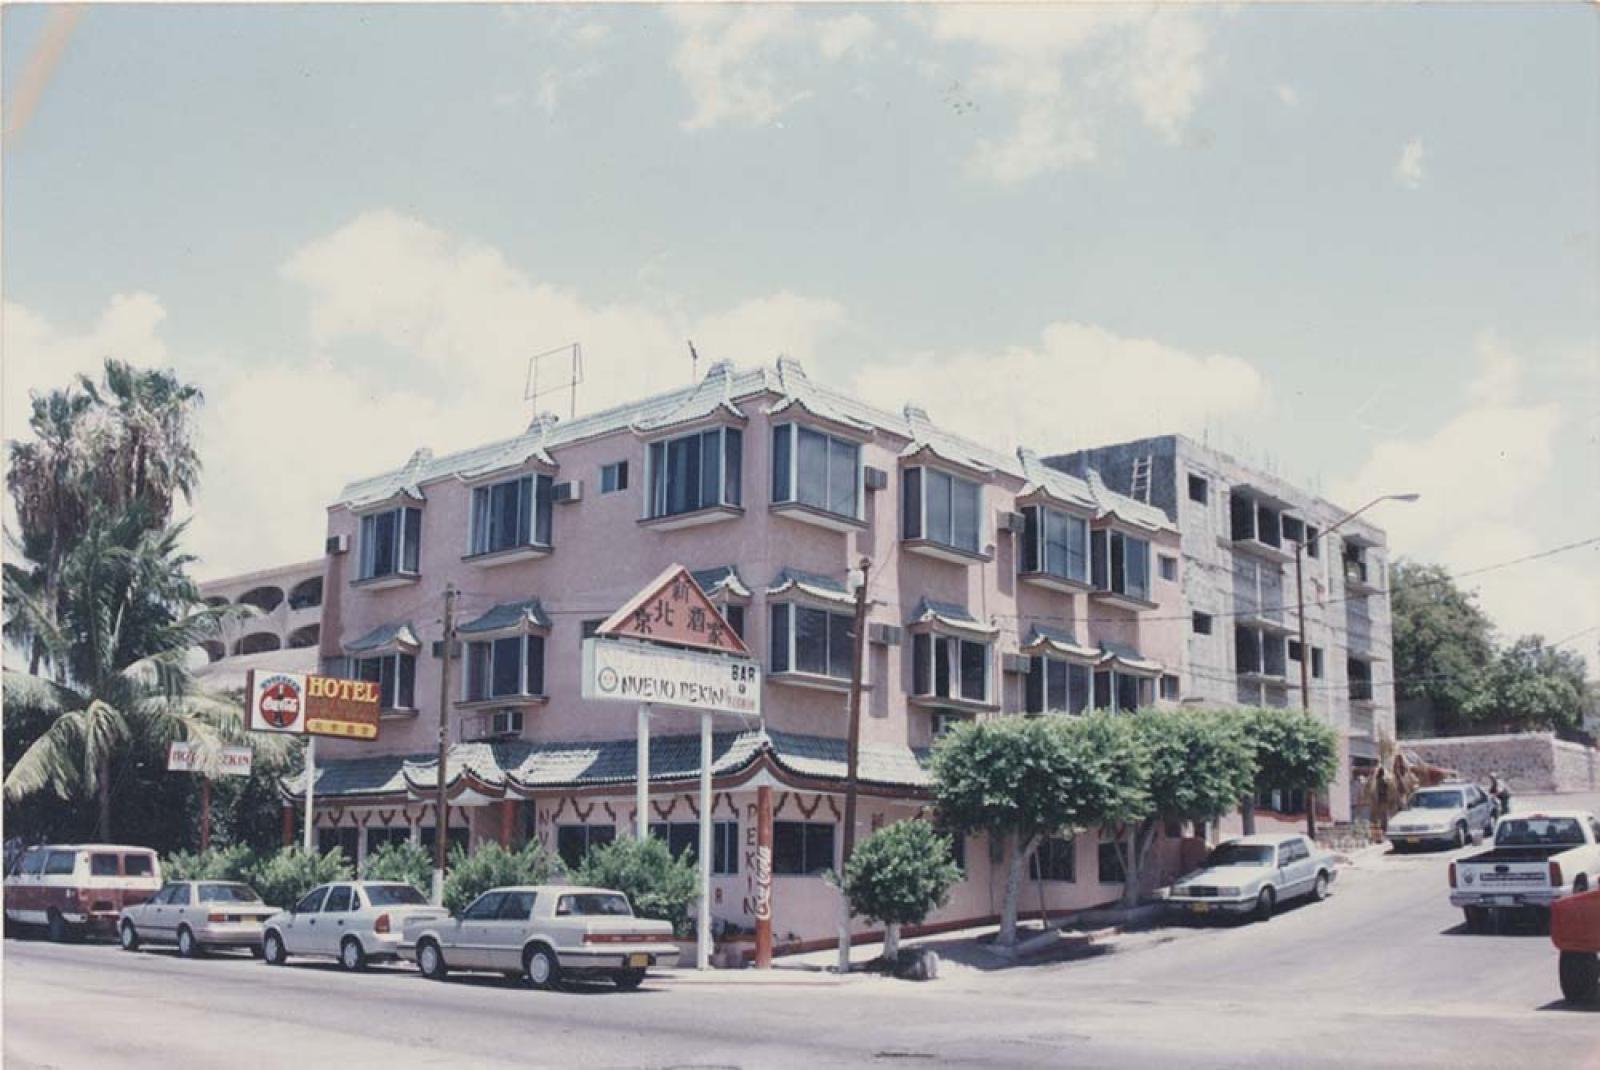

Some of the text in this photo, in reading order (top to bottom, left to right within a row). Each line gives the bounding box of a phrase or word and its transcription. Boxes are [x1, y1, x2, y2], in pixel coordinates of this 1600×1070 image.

[732, 664, 756, 683] BAR
[308, 676, 379, 703] HOTEL
[622, 675, 676, 699] NUEVO
[743, 803, 759, 915] PEKIN
